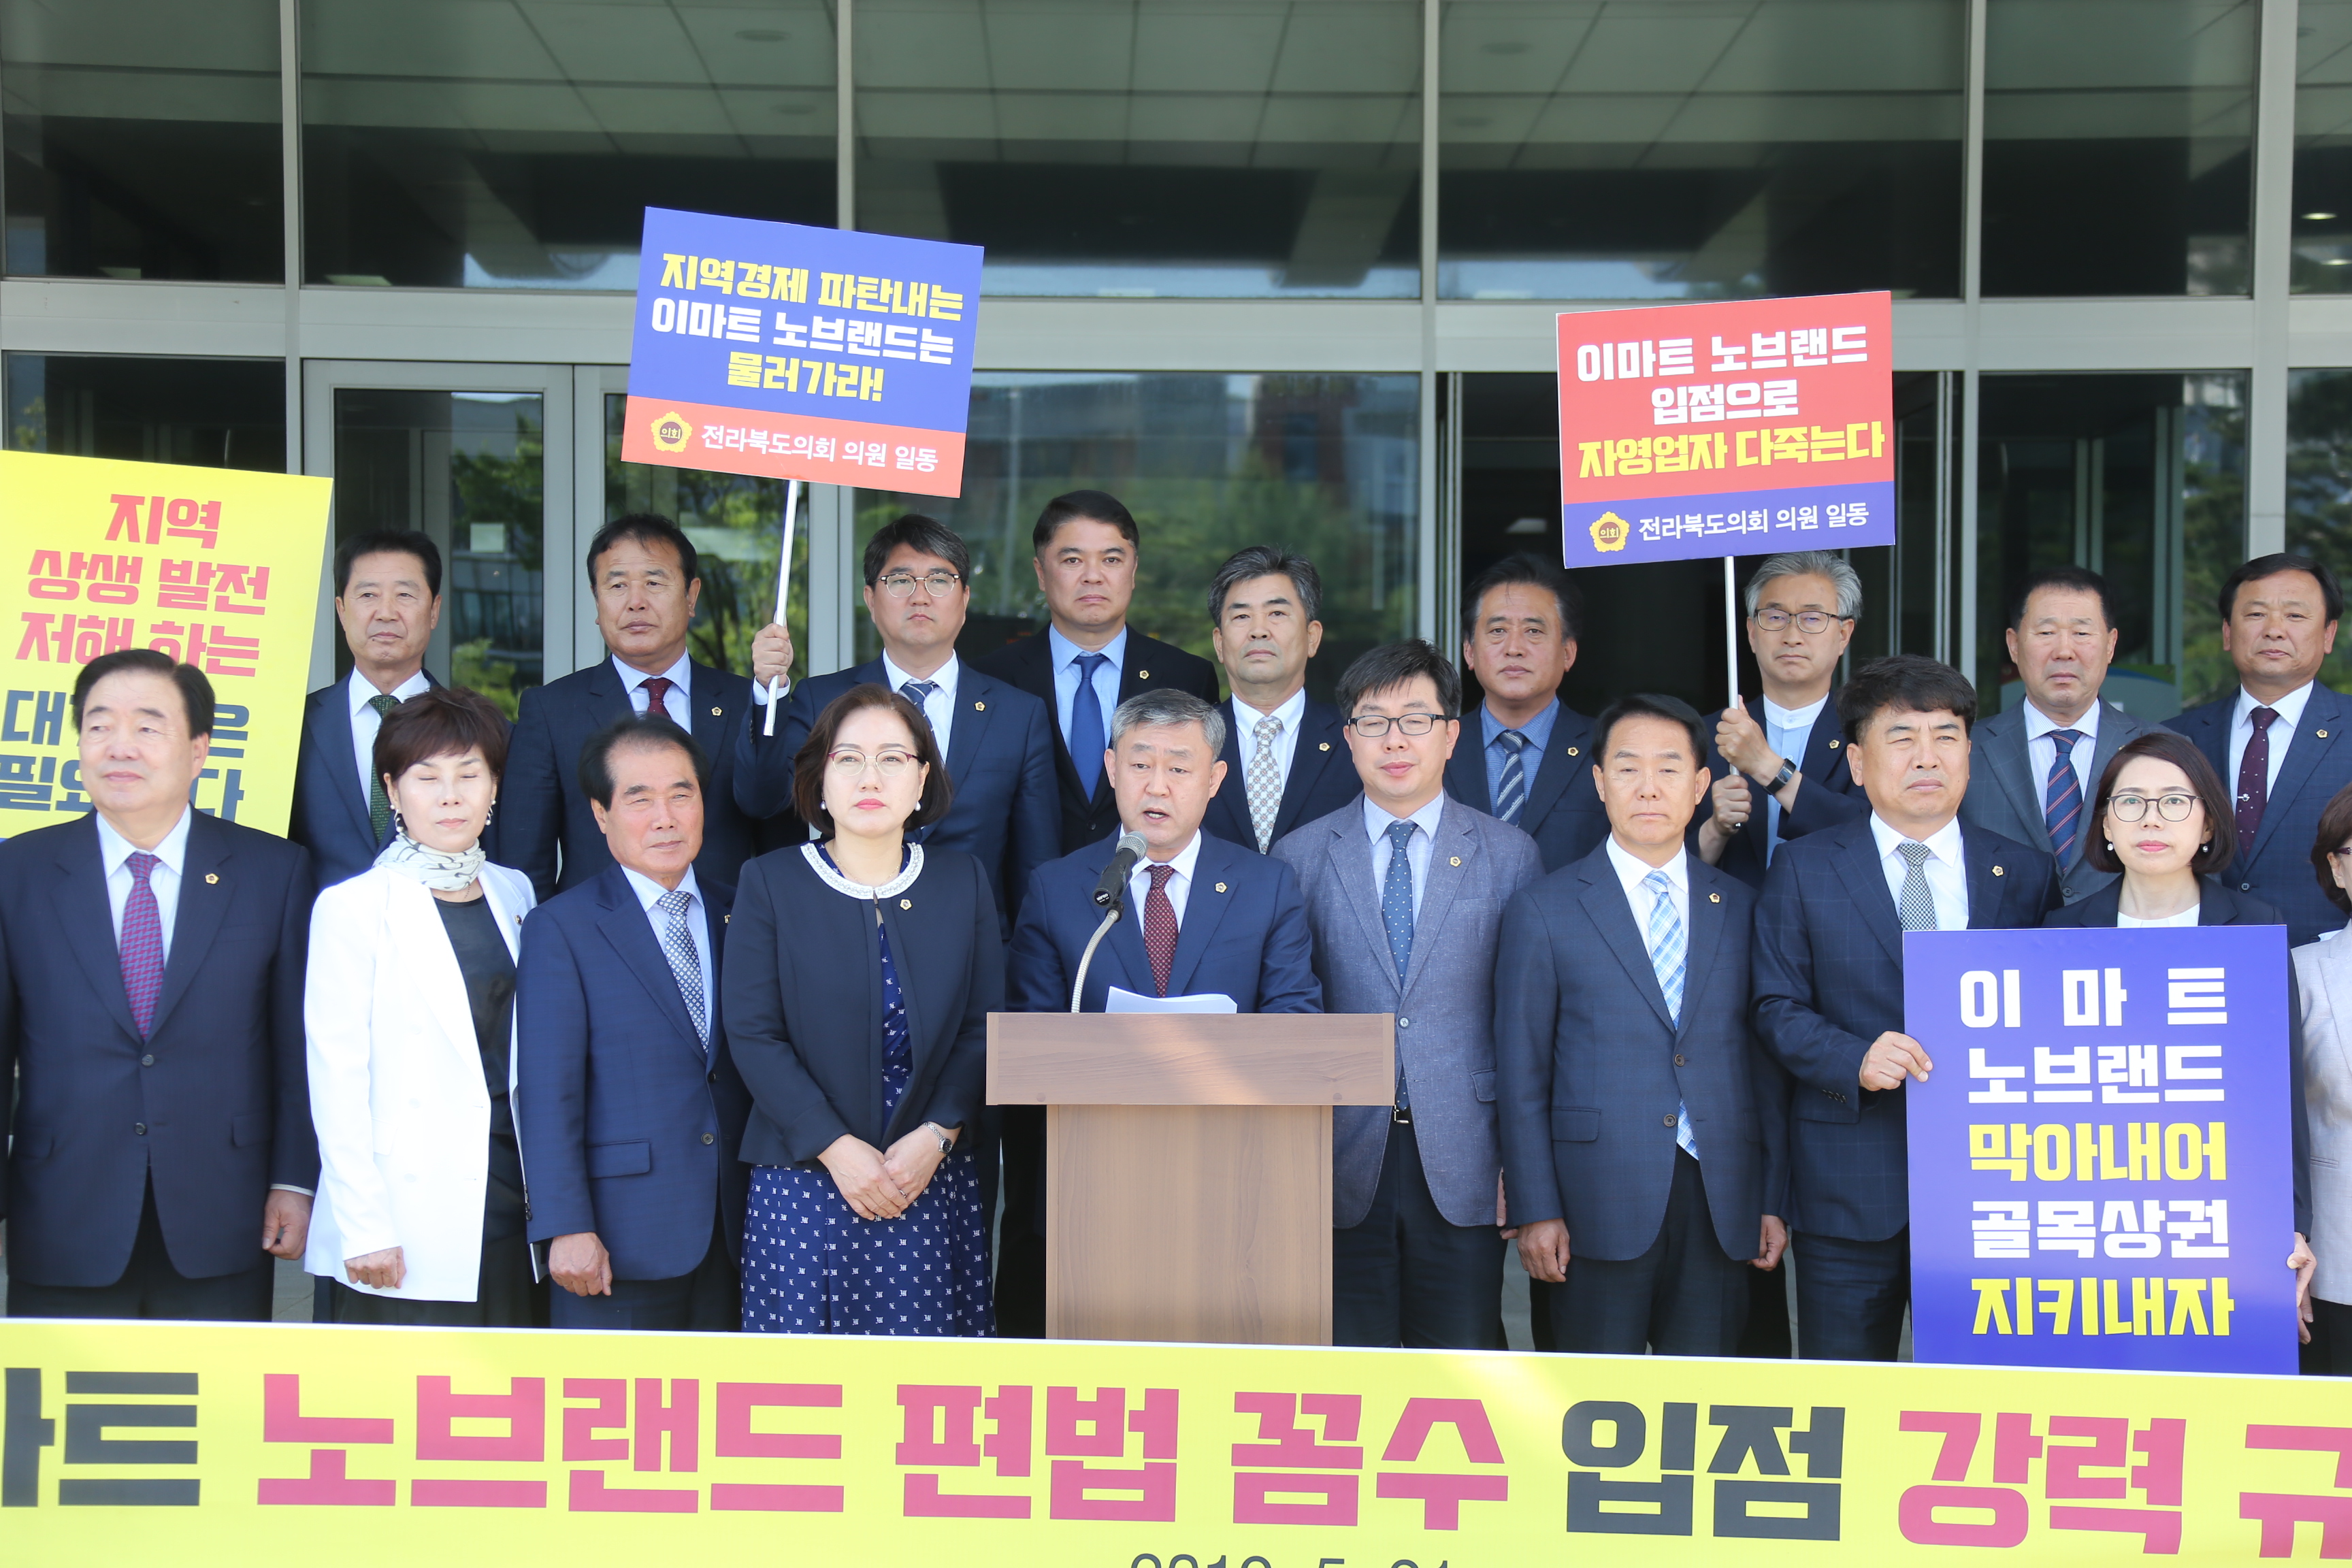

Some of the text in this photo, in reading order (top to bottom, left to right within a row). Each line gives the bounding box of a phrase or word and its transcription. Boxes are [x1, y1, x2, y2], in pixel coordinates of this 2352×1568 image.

[662, 254, 962, 321] 지역경제 파탄내는
[651, 297, 954, 365] 이마트 노브랜드는
[1577, 326, 1867, 382] 이마트 노브랜드
[728, 352, 883, 401] 물러가라!
[1651, 378, 1799, 425] 입점으로
[659, 427, 681, 440] 의회
[701, 425, 938, 472] 전라북도의회 의원 일동
[1578, 421, 1885, 478] 자영업자 다죽는다
[105, 493, 222, 549] 지역
[1599, 526, 1620, 539] 의회
[1638, 502, 1869, 541] 전라북도의회 의원 일동
[29, 550, 270, 615] 상생 발전
[147, 620, 260, 677] 하는
[1968, 1045, 2225, 1104] 노브랜드
[1970, 1122, 2227, 1181] 막아내어
[1972, 1199, 2230, 1258] 골목상권
[1972, 1277, 2234, 1336] 지키내자
[259, 1373, 844, 1513] 노브랜드
[896, 1384, 1179, 1522] 편법
[1232, 1392, 1507, 1531] 꼼수
[1563, 1401, 1844, 1541] 입점
[1899, 1411, 2186, 1554] 강력
